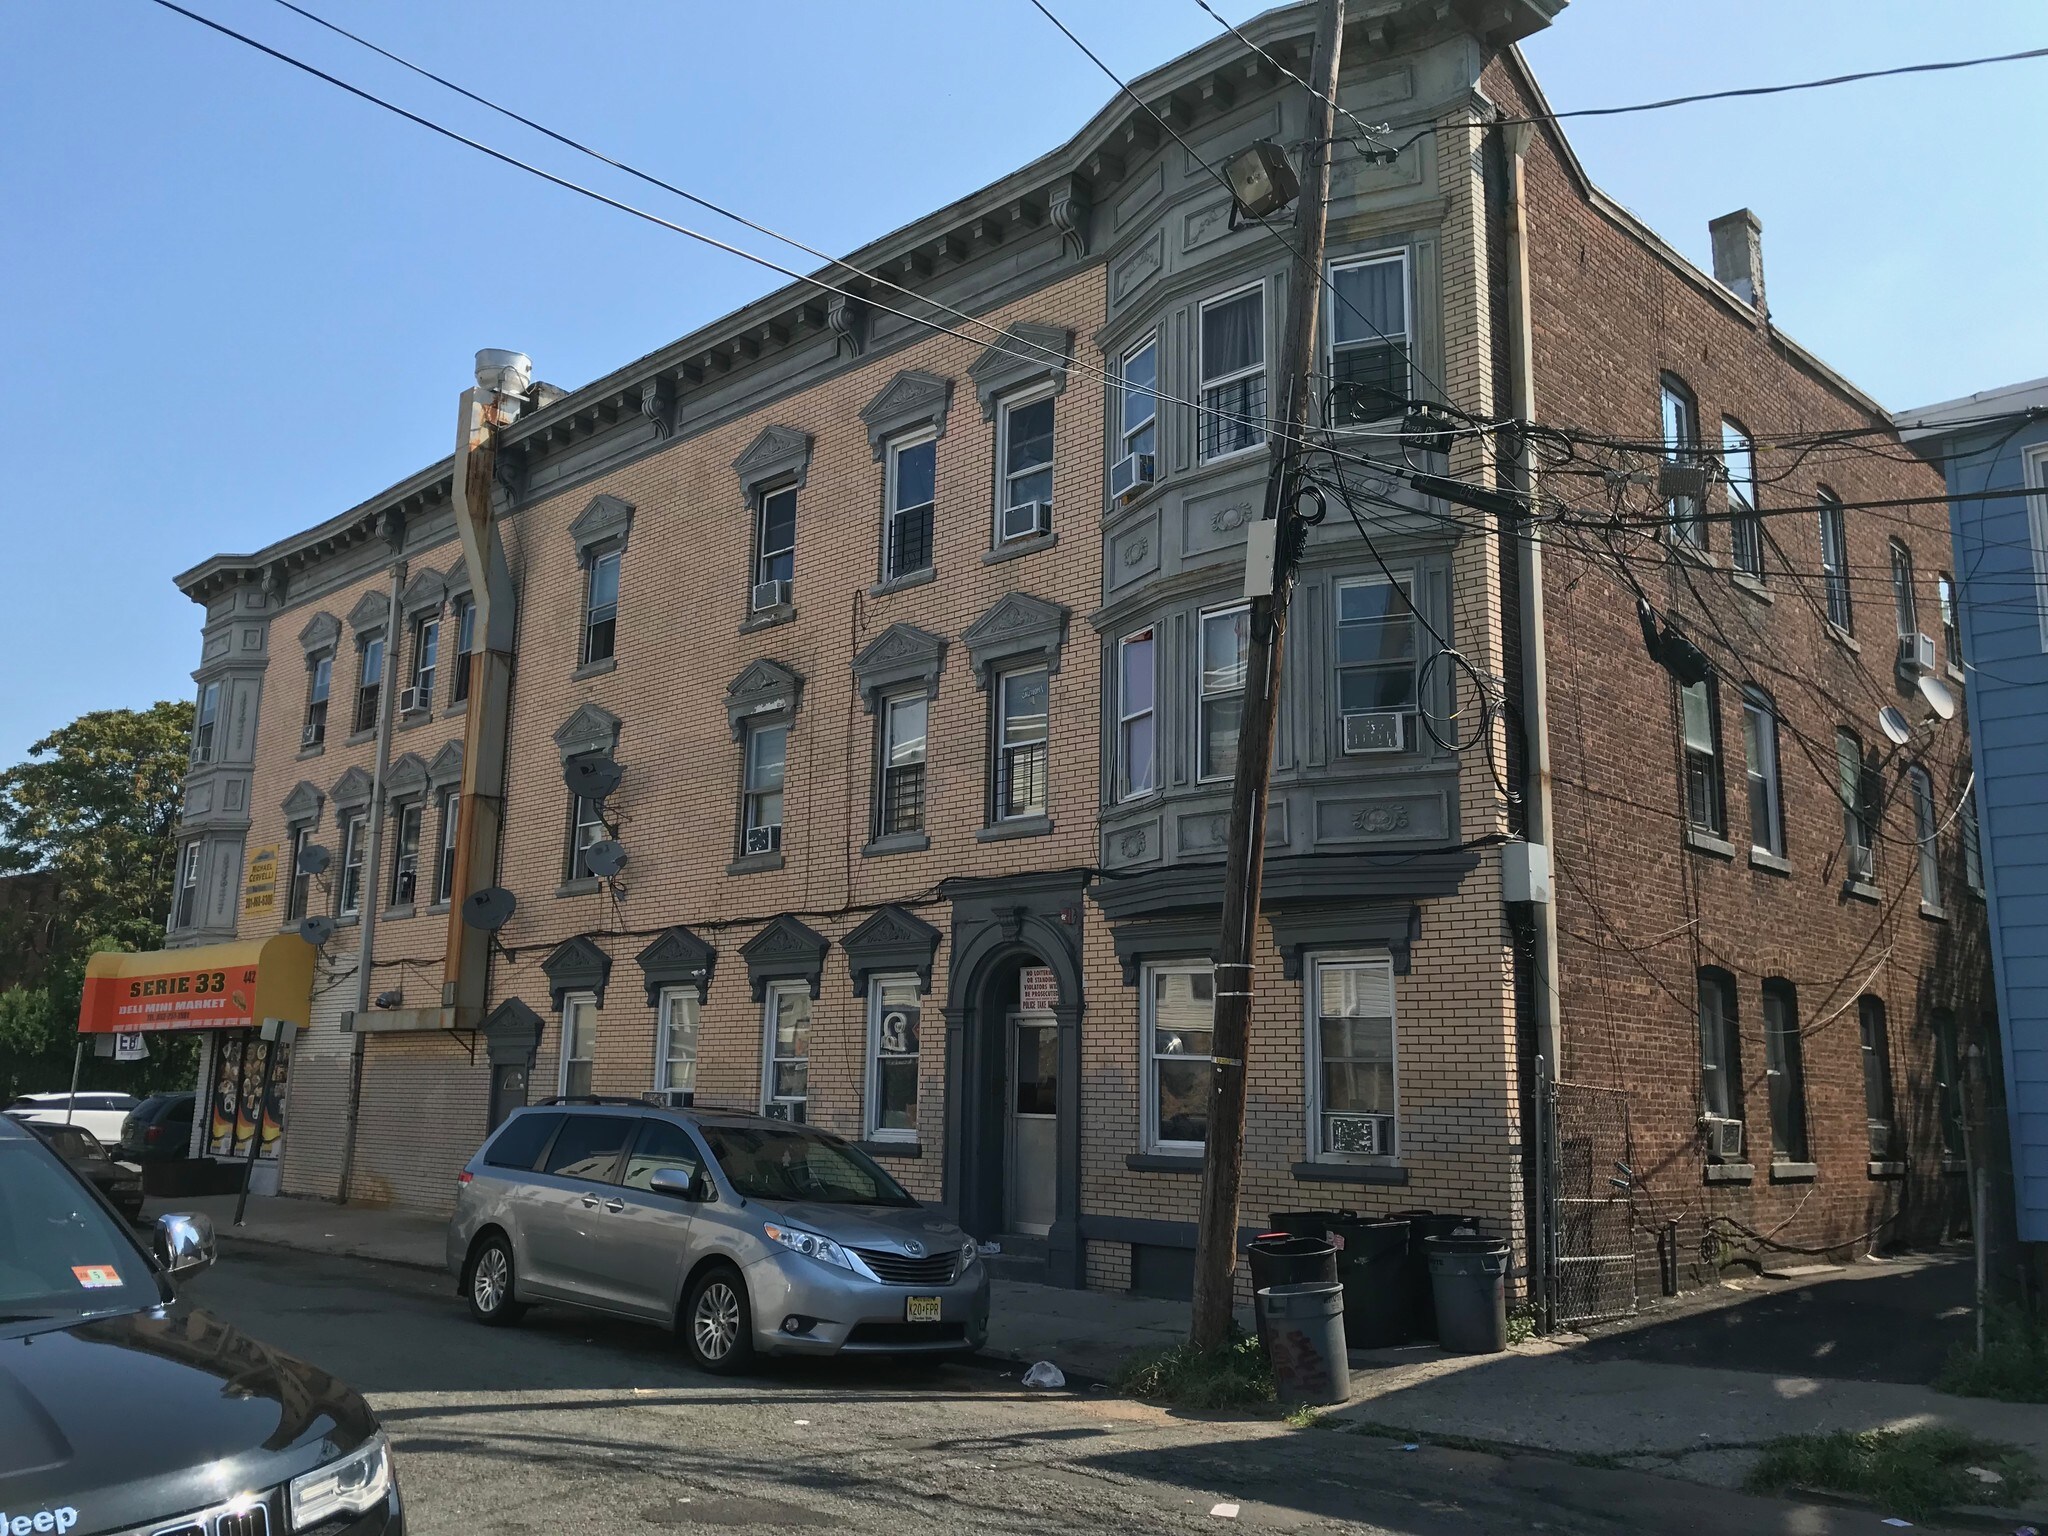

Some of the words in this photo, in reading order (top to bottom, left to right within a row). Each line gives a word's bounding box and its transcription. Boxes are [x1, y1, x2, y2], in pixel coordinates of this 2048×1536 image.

[249, 871, 274, 883] CERVELLI
[129, 977, 191, 998] SERIE
[195, 972, 226, 994] 33
[119, 1004, 143, 1015] DELI
[145, 1002, 173, 1013] MINI
[175, 998, 227, 1010] MARKET
[1023, 1001, 1036, 1009] POLICE
[0, 1507, 79, 1536] Jeep
